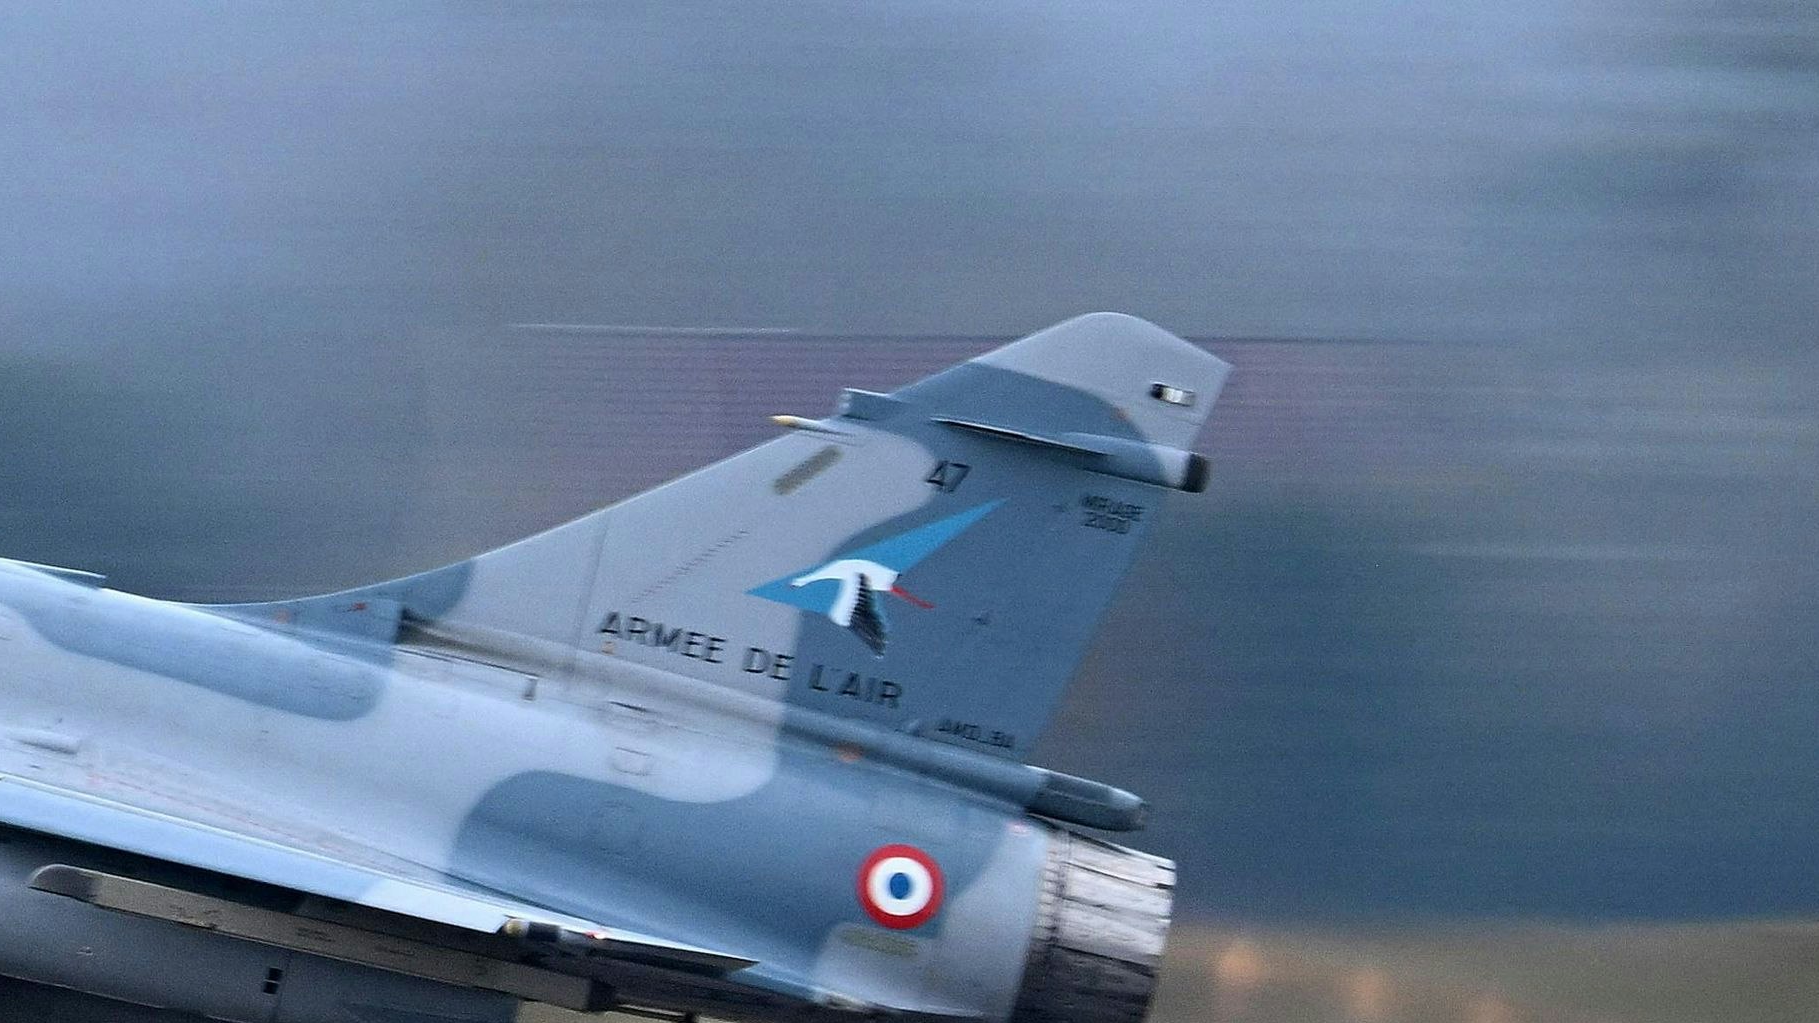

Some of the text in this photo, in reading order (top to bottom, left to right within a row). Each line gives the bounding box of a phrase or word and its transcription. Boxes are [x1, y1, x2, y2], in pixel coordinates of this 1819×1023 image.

[926, 460, 971, 493] 47
[598, 611, 903, 708] ARMEE DE L'AIR
